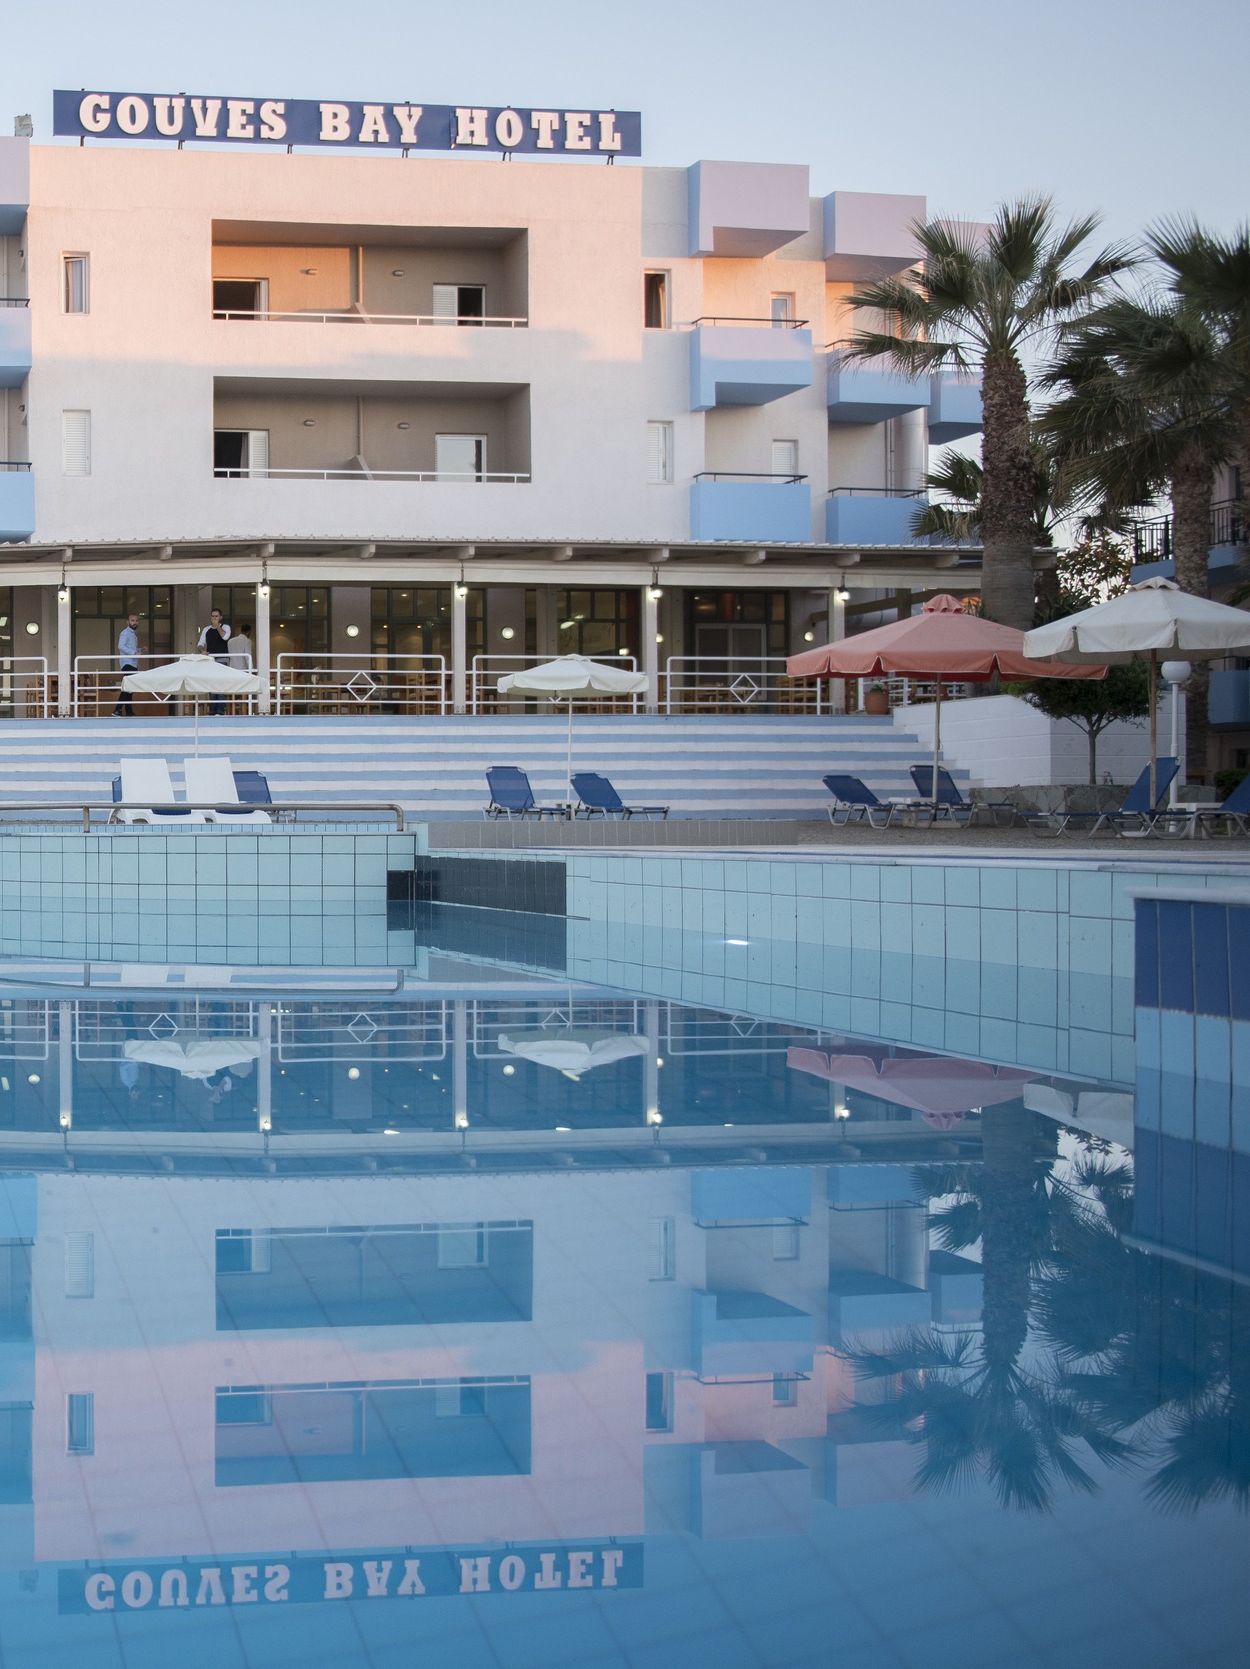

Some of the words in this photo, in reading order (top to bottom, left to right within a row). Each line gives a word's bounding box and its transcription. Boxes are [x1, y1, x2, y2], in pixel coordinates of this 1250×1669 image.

[79, 93, 288, 140] GOUVES
[319, 102, 424, 144] BAY
[455, 107, 623, 151] HOTEL
